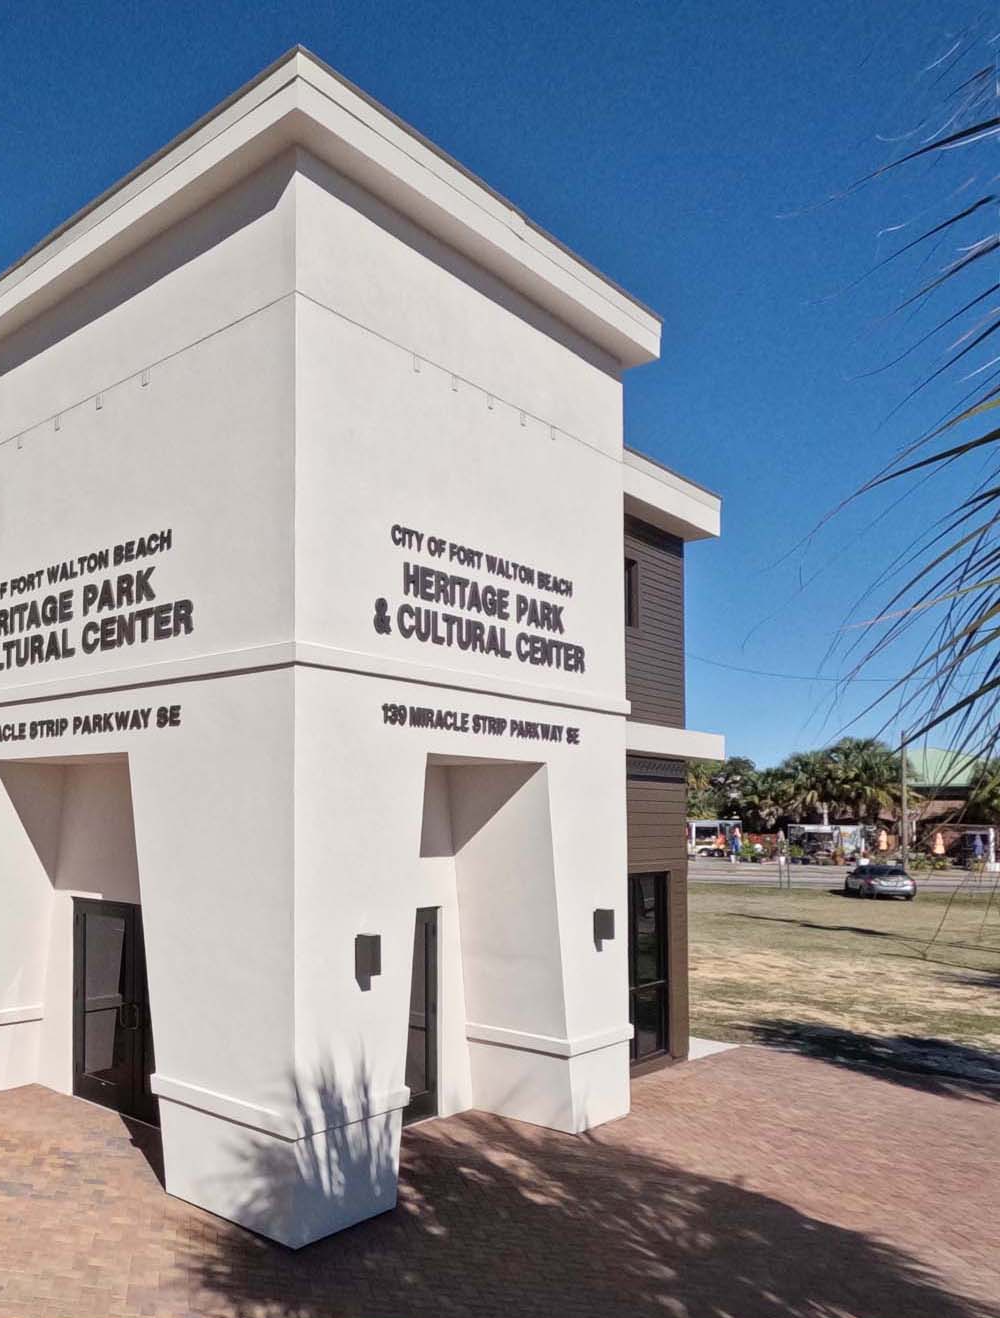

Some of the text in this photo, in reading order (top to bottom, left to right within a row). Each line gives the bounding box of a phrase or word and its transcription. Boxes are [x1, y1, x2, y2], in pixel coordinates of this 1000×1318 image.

[10, 570, 44, 597] FORT
[47, 549, 109, 585] WALTON
[113, 529, 172, 566] BEACH
[391, 524, 573, 597] CITY OF FORT WALTON BEACH
[83, 567, 155, 616] PARK
[403, 562, 564, 634] HERITAGE PARK
[82, 599, 194, 654] CENTER
[374, 598, 585, 673] & CULTURAL CENTER
[30, 718, 68, 739] STRIP
[73, 708, 152, 735] PARKWAY
[156, 705, 181, 728] SE
[382, 704, 580, 744] 139 MIRACLE STRIP PARKWAY SE
